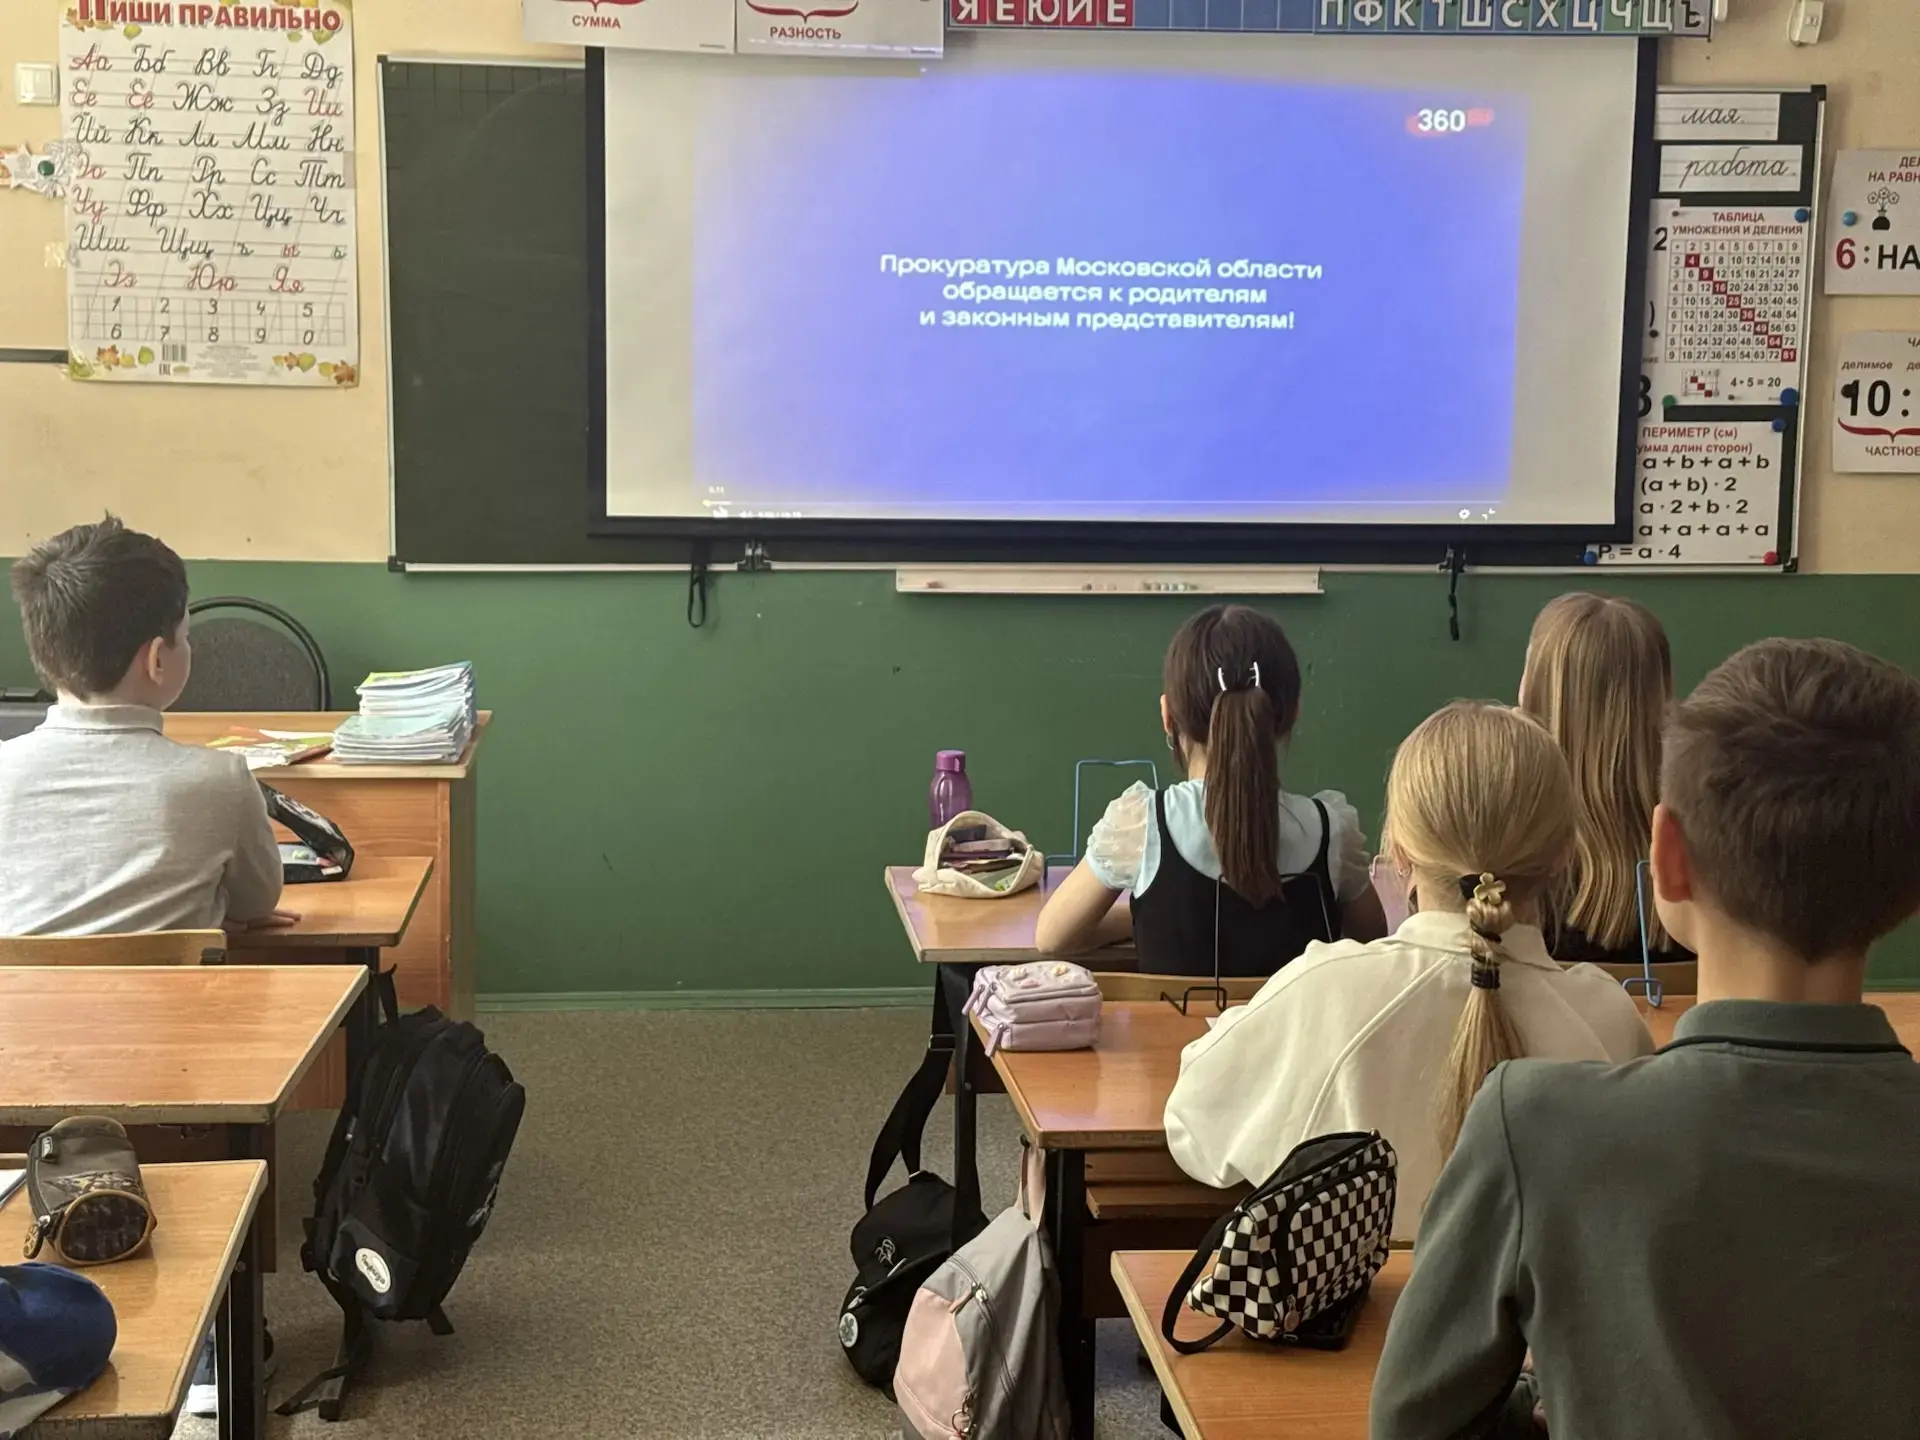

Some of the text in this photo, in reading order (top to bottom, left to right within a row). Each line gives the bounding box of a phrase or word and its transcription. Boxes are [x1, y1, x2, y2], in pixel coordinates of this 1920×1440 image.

[179, 4, 342, 31] ПРАВИЛЬНО
[572, 15, 621, 30] СУММА
[769, 26, 842, 40] РАЗНОСТЬ
[1417, 108, 1466, 132] 360
[1868, 171, 1885, 182] НА
[1712, 212, 1765, 223] ТАБЛИЦА
[1672, 225, 1803, 236] УМНОЖЕНИЯ И ДЕЛЕНИЯ
[1836, 238, 1856, 270] 6
[880, 254, 1323, 280] Прокуратура Московской области
[943, 281, 1267, 306] обращается к родителям
[1672, 283, 1799, 292] 4 8 12 16 20 24 28 32 36
[112, 296, 313, 316] 1 2 3 4 5
[919, 310, 1295, 332] и законным представителям!
[111, 323, 314, 345] 6 7 8 9 0
[1669, 351, 1675, 360] 9
[1683, 351, 1693, 360] 18
[1696, 351, 1707, 360] 27
[1711, 351, 1722, 360] 36
[1725, 351, 1736, 360] 45
[1739, 351, 1751, 360] 54
[1754, 351, 1765, 360] 63
[1768, 351, 1780, 360] 72
[1783, 351, 1794, 360] 81
[1841, 361, 1893, 371] делимое
[1730, 377, 1737, 387] 4
[1747, 377, 1754, 387] 5
[1767, 377, 1781, 387] 20
[1843, 379, 1891, 417] 10
[1642, 427, 1738, 440] ПЕРИМЕТР (см)
[1671, 444, 1703, 454] длин
[1706, 442, 1753, 455] сторон)
[1865, 446, 1920, 456] ЧАСТНОЕ
[1642, 458, 1657, 469] a
[1681, 455, 1694, 469] b
[1718, 458, 1732, 469] a
[1756, 454, 1770, 469] b
[1641, 477, 1663, 495] (a
[1687, 477, 1708, 495] b)
[1724, 477, 1737, 491] 2
[1640, 502, 1654, 514] a
[1670, 499, 1683, 514] 2
[1706, 499, 1719, 514] b
[1735, 499, 1749, 514] 2
[1638, 524, 1653, 536] a
[1677, 524, 1691, 536] a
[1715, 524, 1730, 536] a
[1754, 524, 1769, 536] a
[1598, 544, 1612, 559] P
[1638, 546, 1652, 559] a
[1668, 544, 1681, 559] 4
